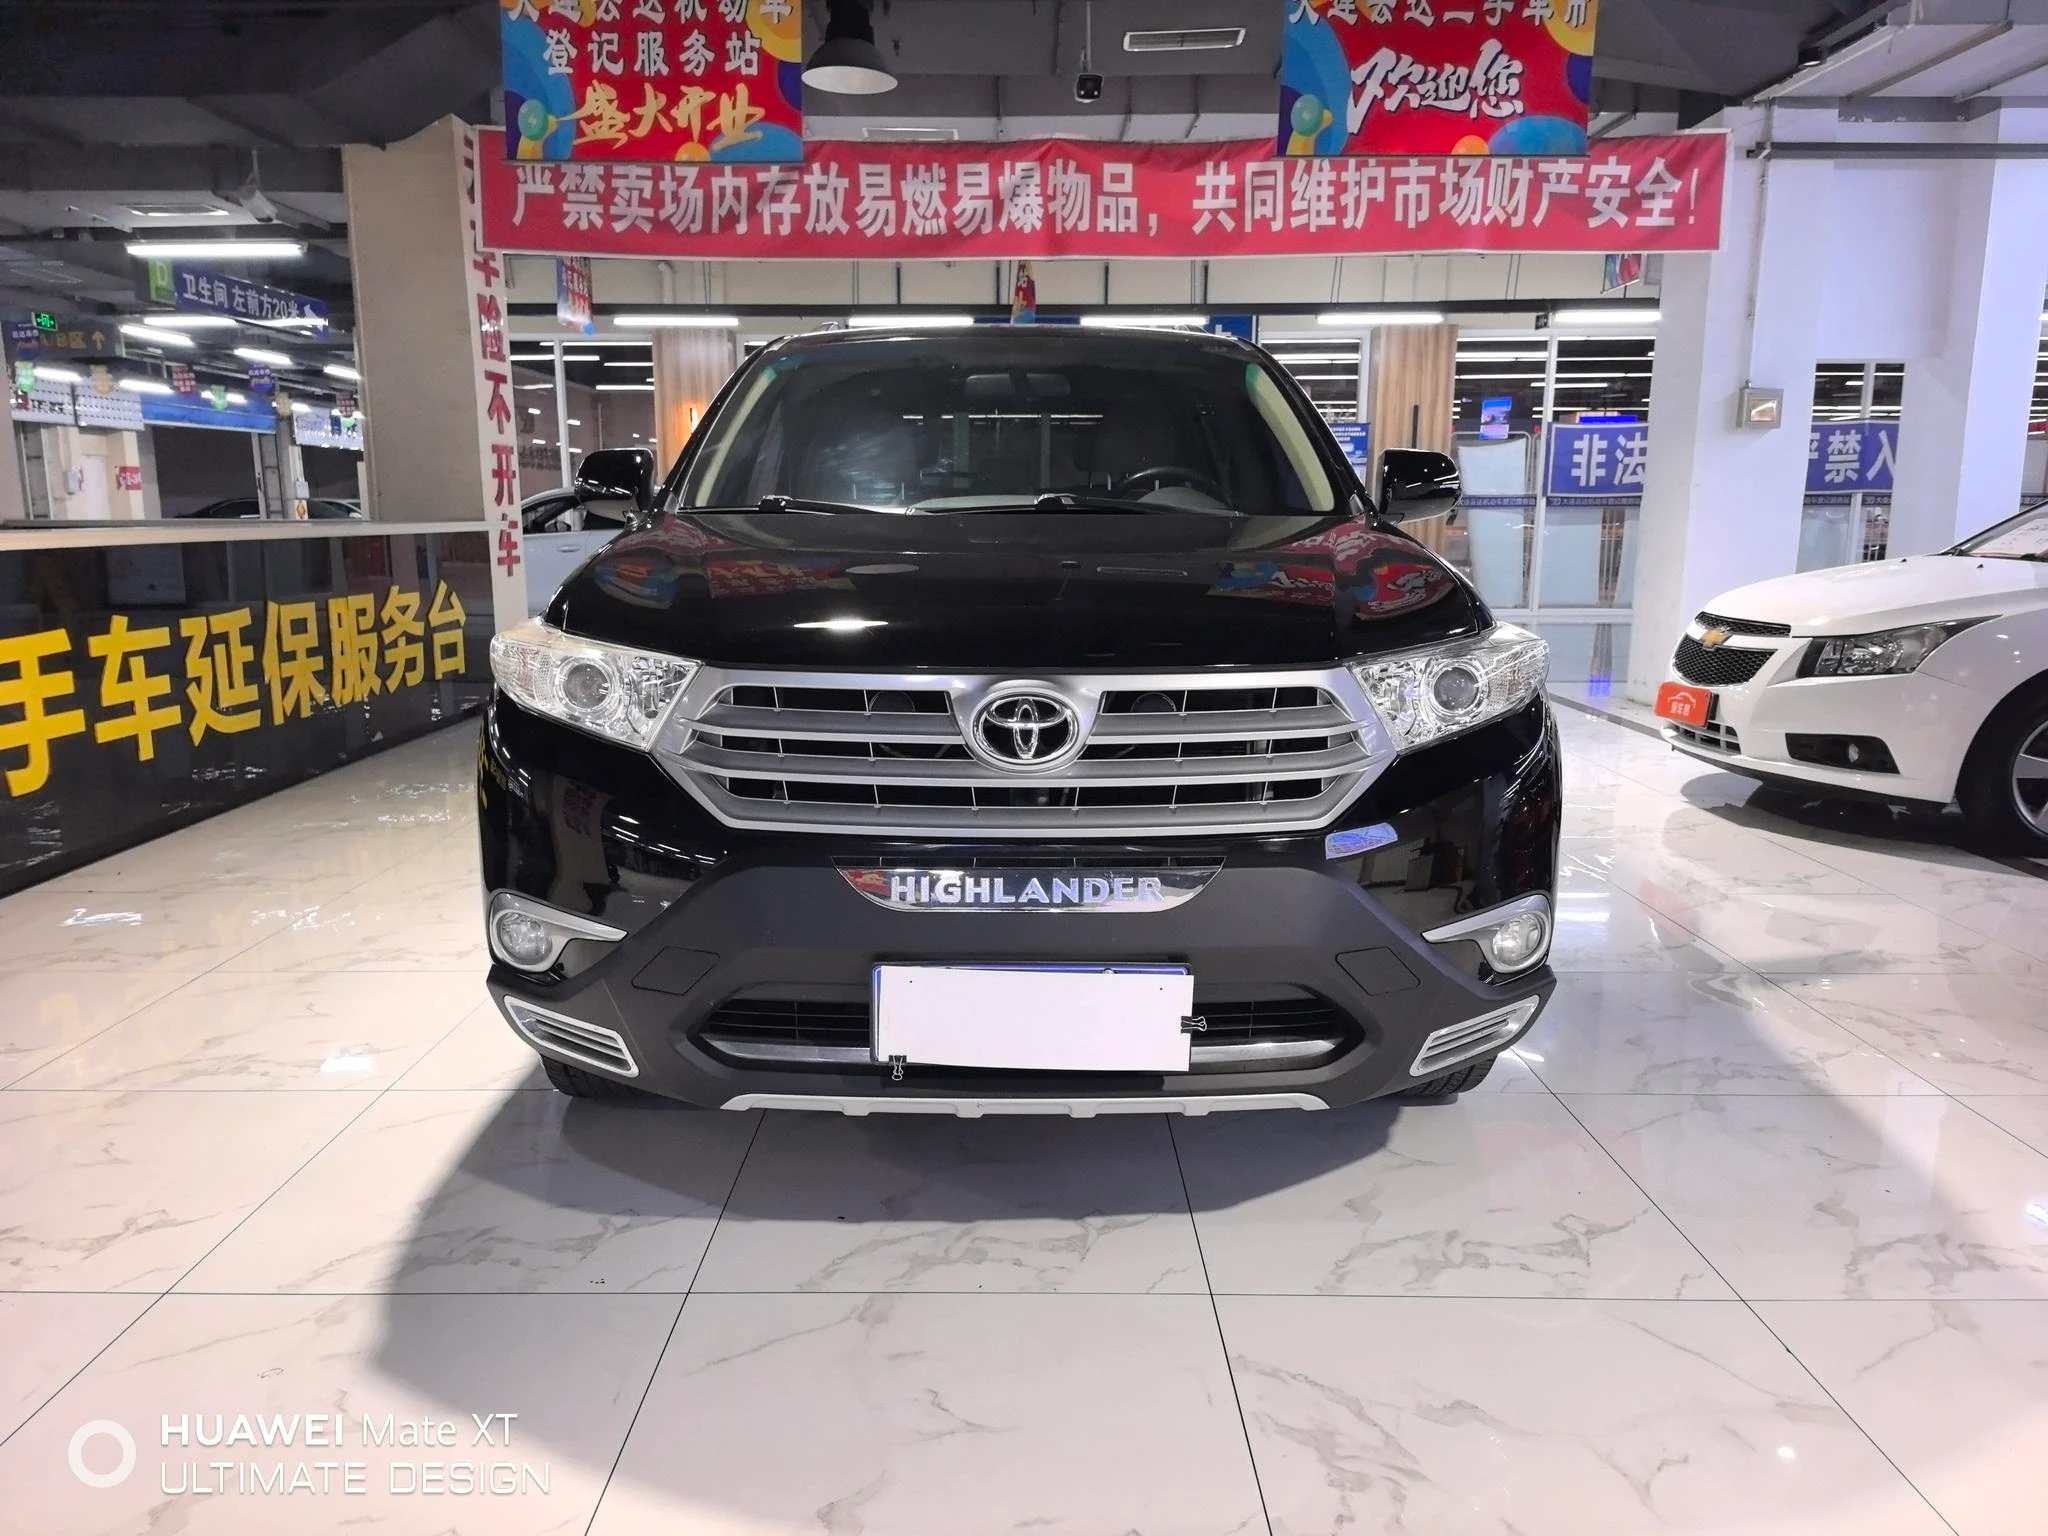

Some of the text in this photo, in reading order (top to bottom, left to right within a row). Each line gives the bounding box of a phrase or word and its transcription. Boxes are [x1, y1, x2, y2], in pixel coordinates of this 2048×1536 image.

[543, 28, 762, 76] 登记服务站
[1346, 38, 1525, 134] 欢迎您
[556, 79, 766, 150] 盛大开业
[182, 273, 228, 309] 卫生间
[1571, 431, 1650, 487] 非法
[0, 579, 467, 798] 手车延保服务台
[890, 876, 1167, 904] HIGHLANDER
